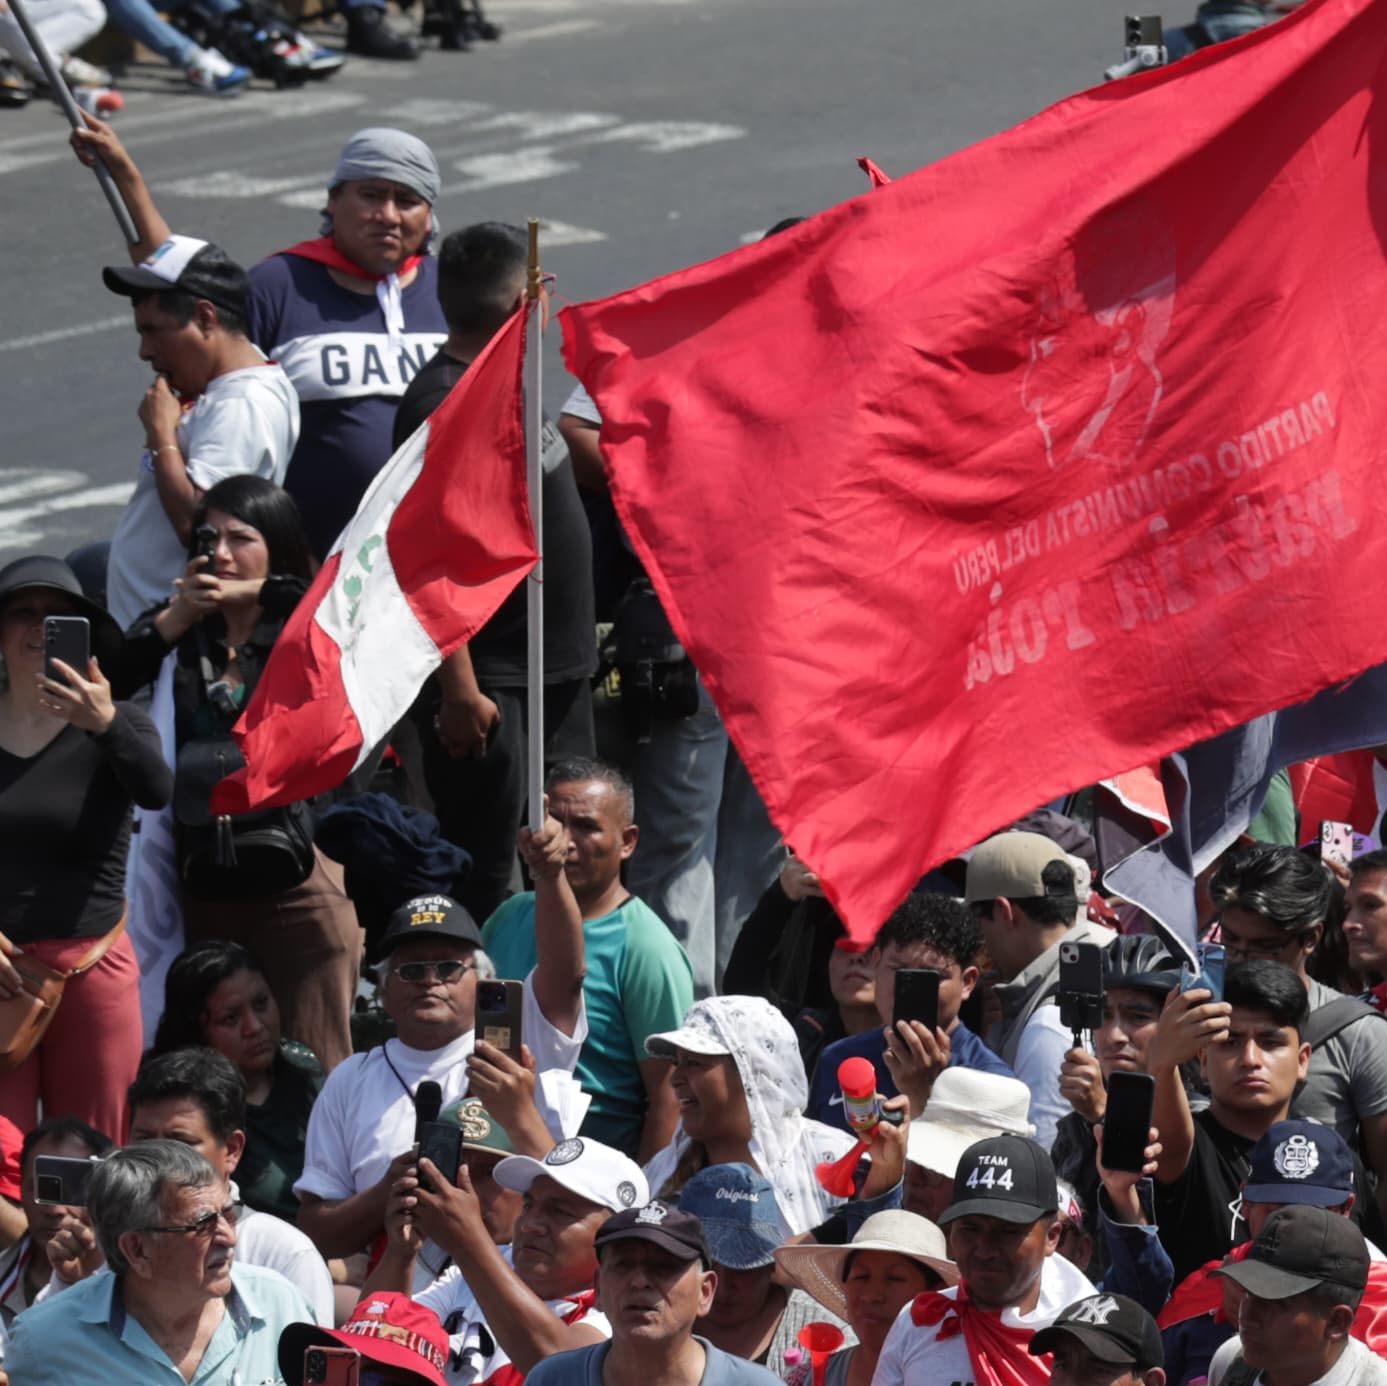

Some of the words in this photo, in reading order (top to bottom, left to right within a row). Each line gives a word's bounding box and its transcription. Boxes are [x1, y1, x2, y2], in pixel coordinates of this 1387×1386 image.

[410, 911, 447, 926] REY
[978, 1155, 1009, 1168] TEAM
[966, 1166, 1014, 1191] 444
[1067, 1295, 1120, 1325] NY
